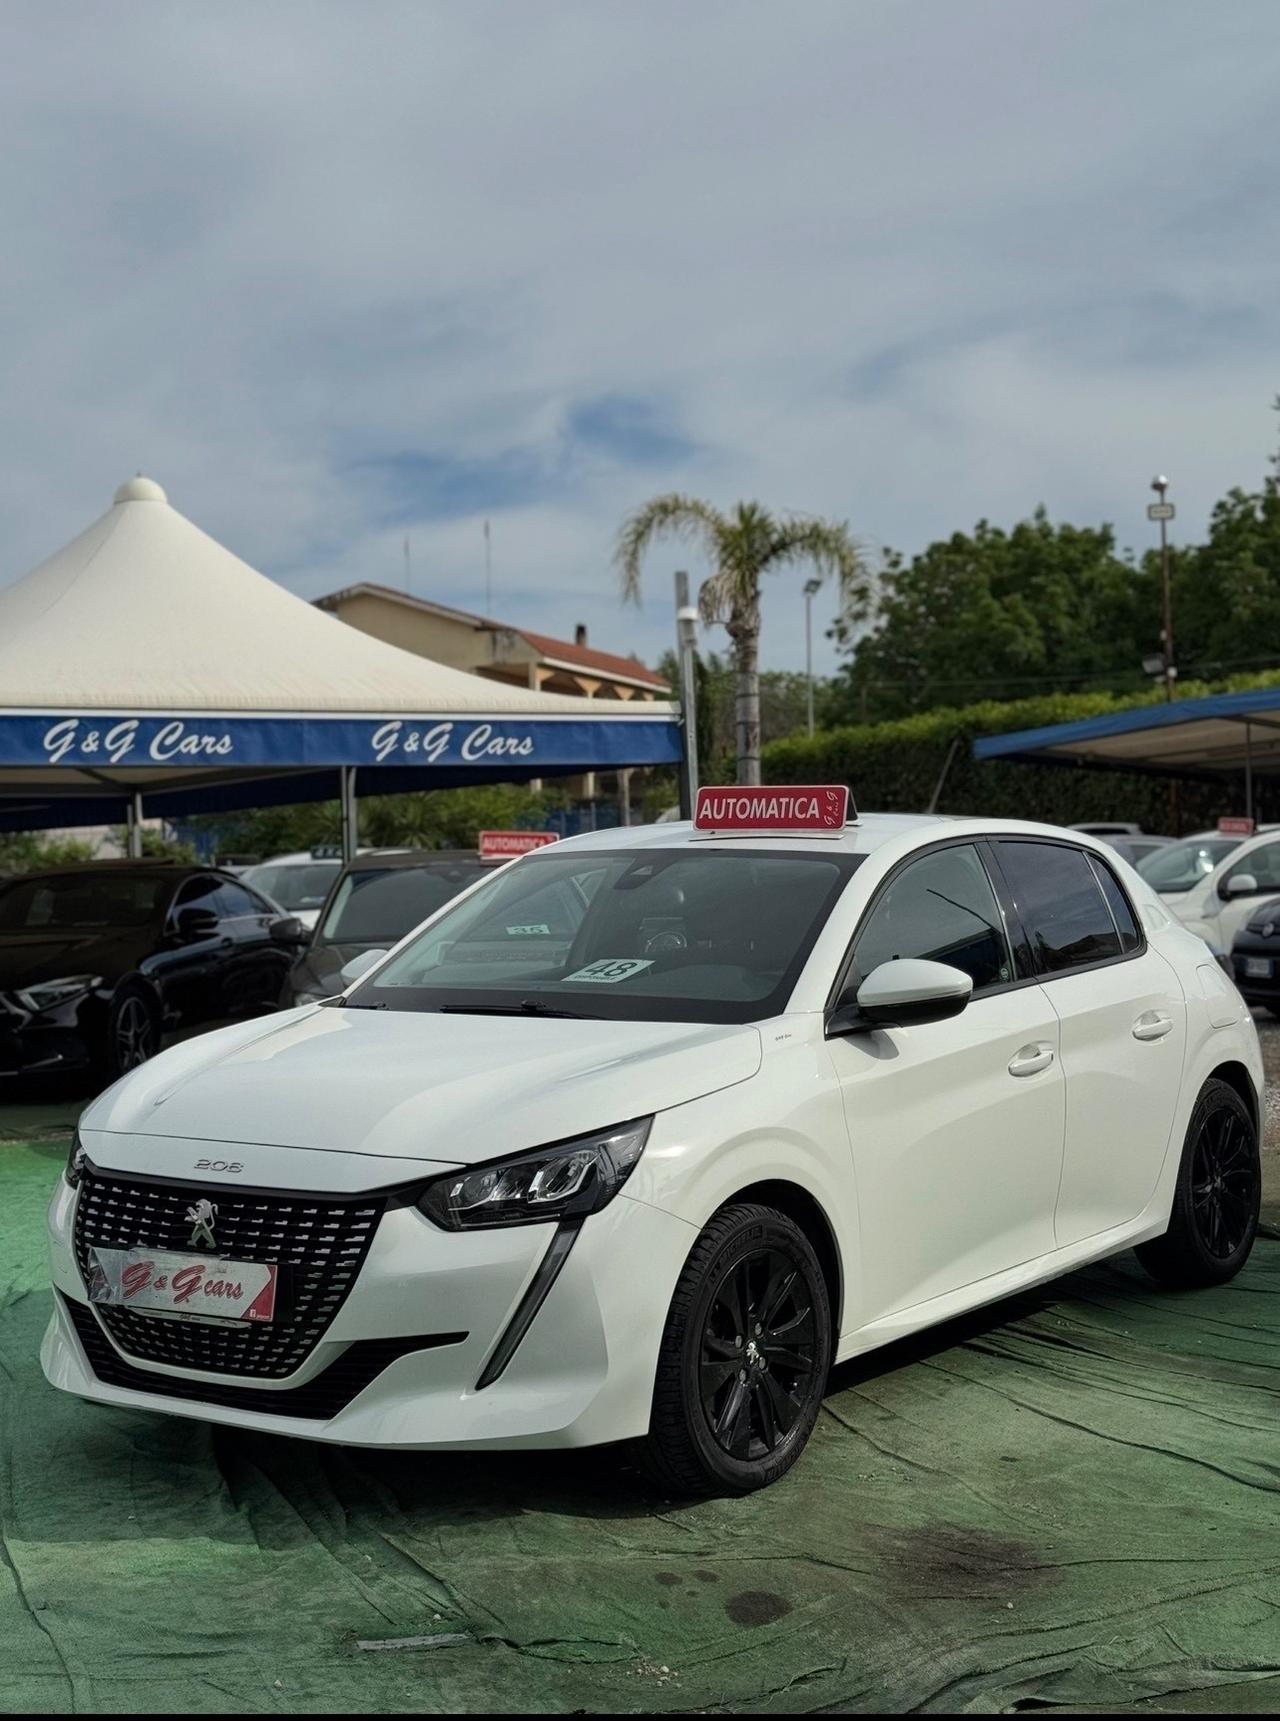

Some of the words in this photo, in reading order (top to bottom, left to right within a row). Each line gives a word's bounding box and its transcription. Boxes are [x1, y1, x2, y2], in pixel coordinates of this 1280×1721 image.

[149, 721, 233, 760] Cars
[461, 724, 534, 760] Cars
[699, 797, 820, 819] AUTOMATICA
[585, 961, 637, 977] 48
